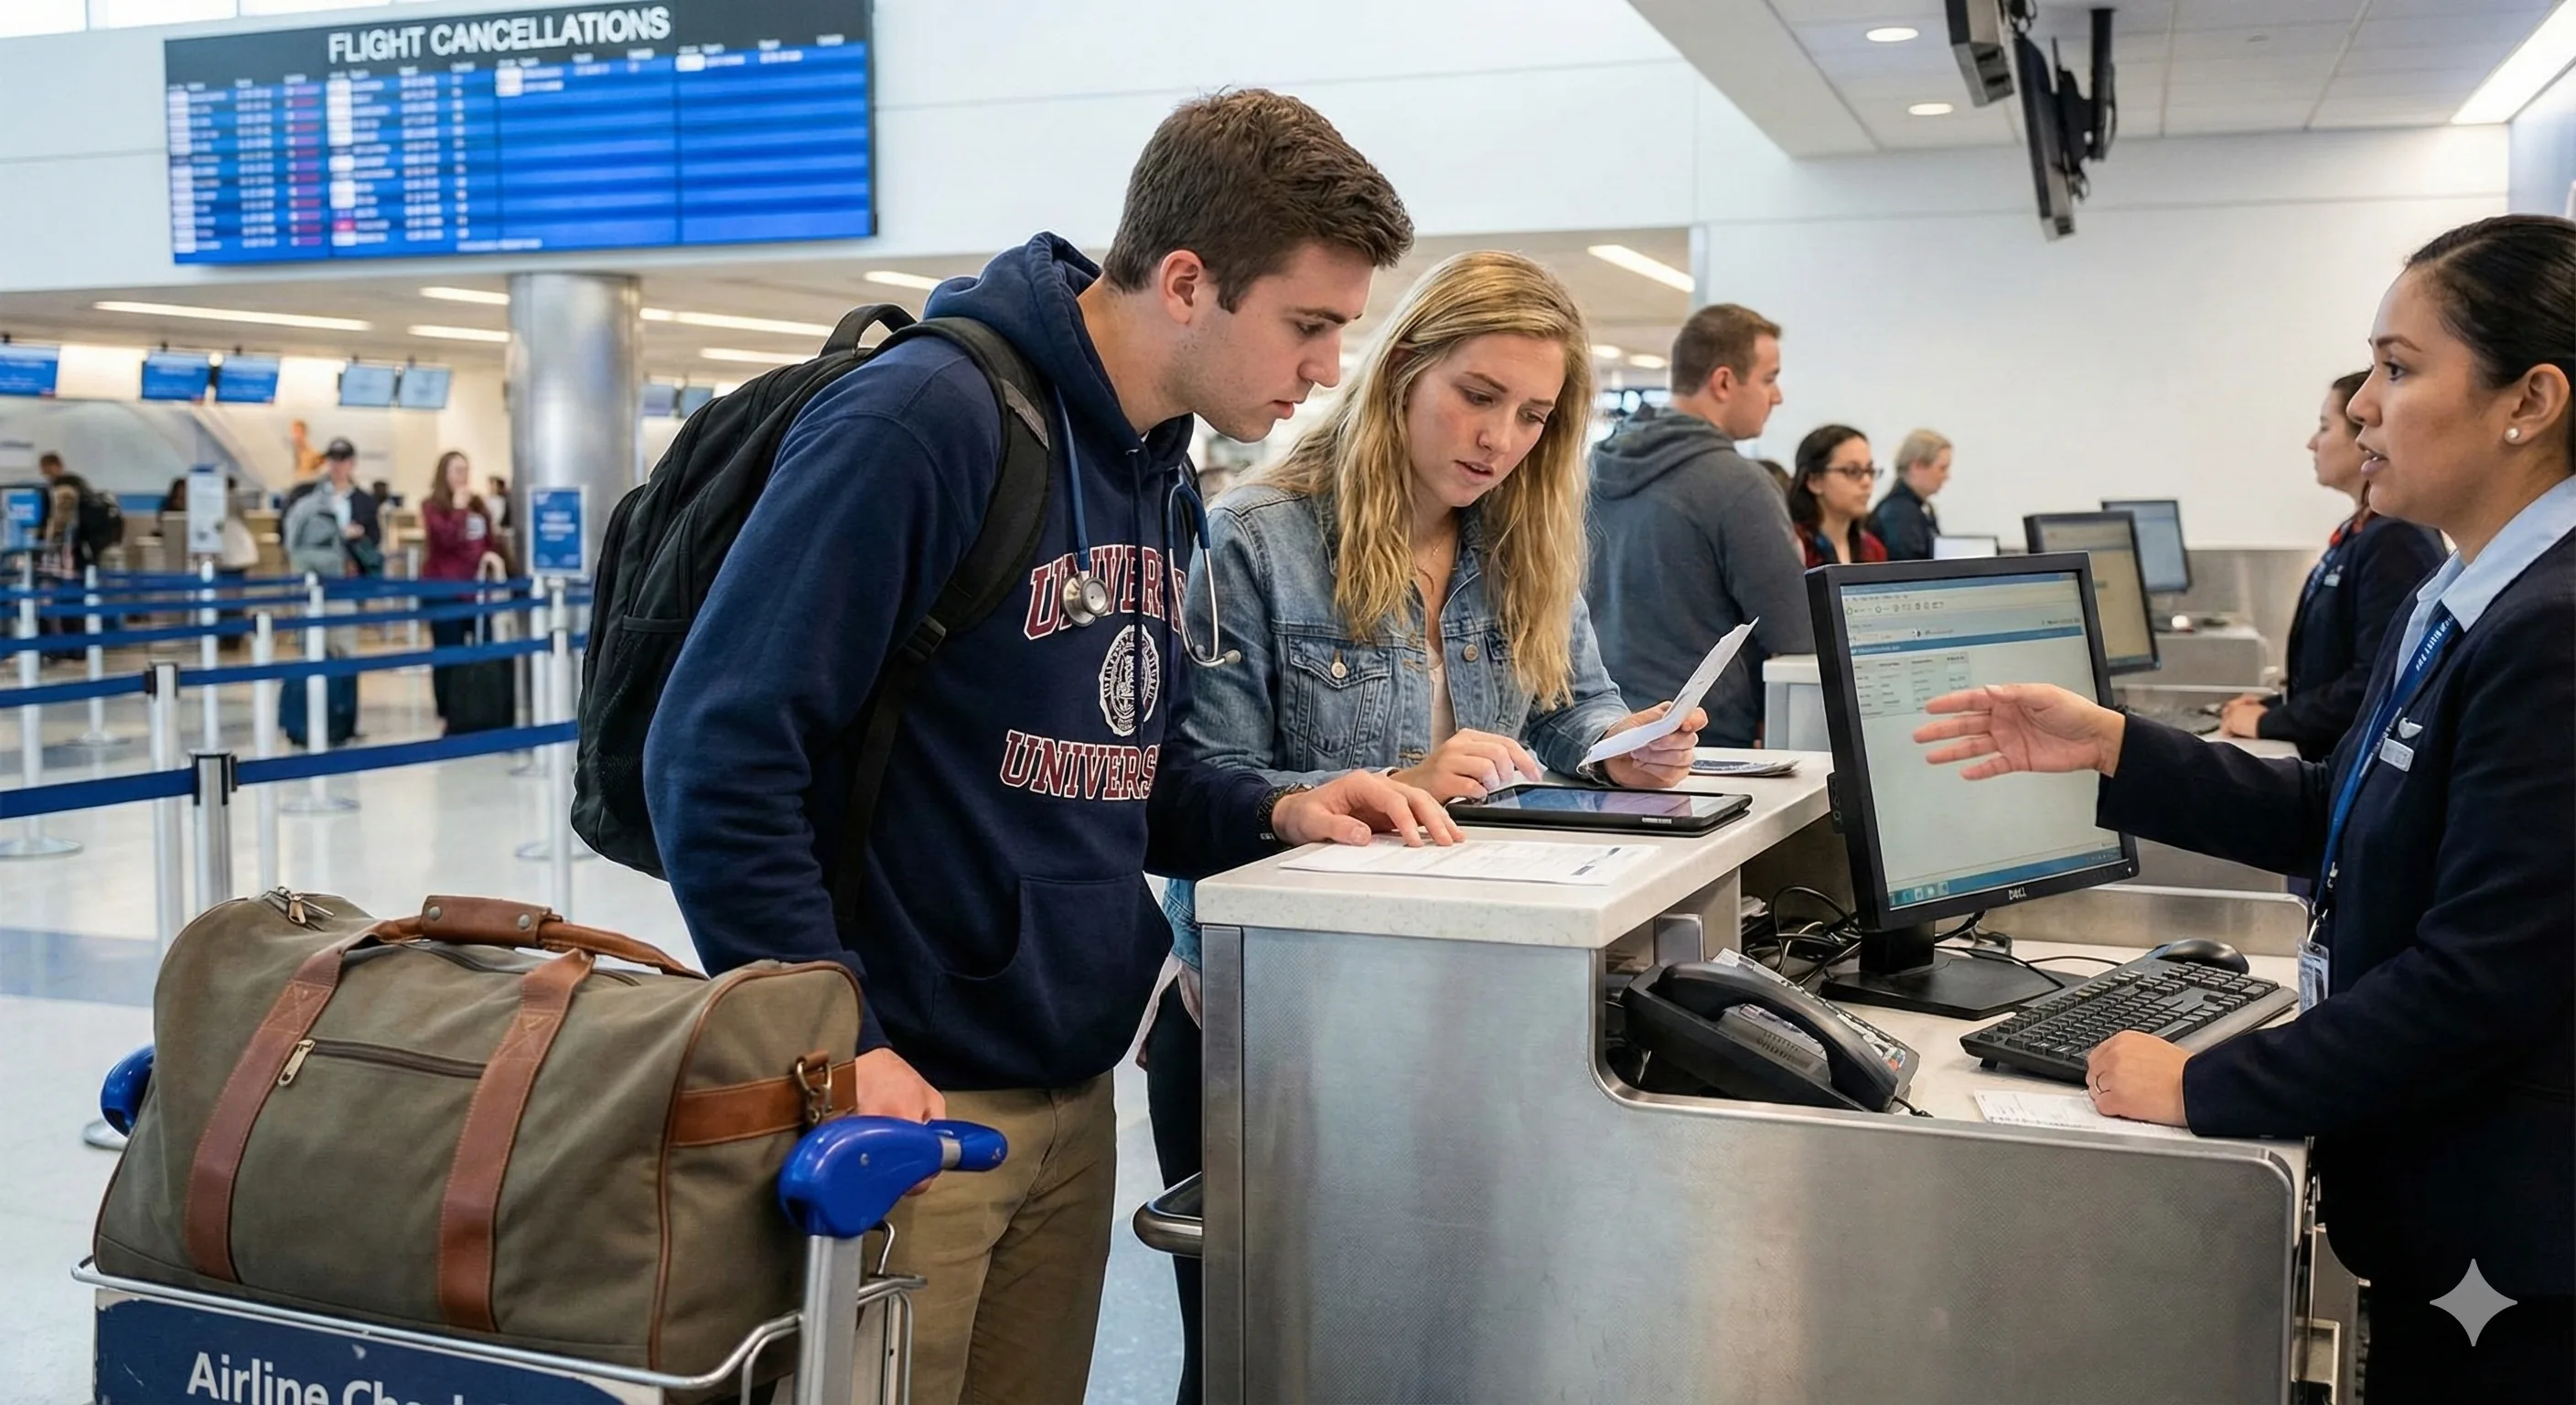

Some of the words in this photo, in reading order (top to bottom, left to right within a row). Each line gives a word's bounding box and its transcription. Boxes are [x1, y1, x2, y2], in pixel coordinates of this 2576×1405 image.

[327, 25, 425, 64] FLIGHT
[430, 5, 671, 57] CANCELLATIONS
[187, 1351, 329, 1405] Airline
